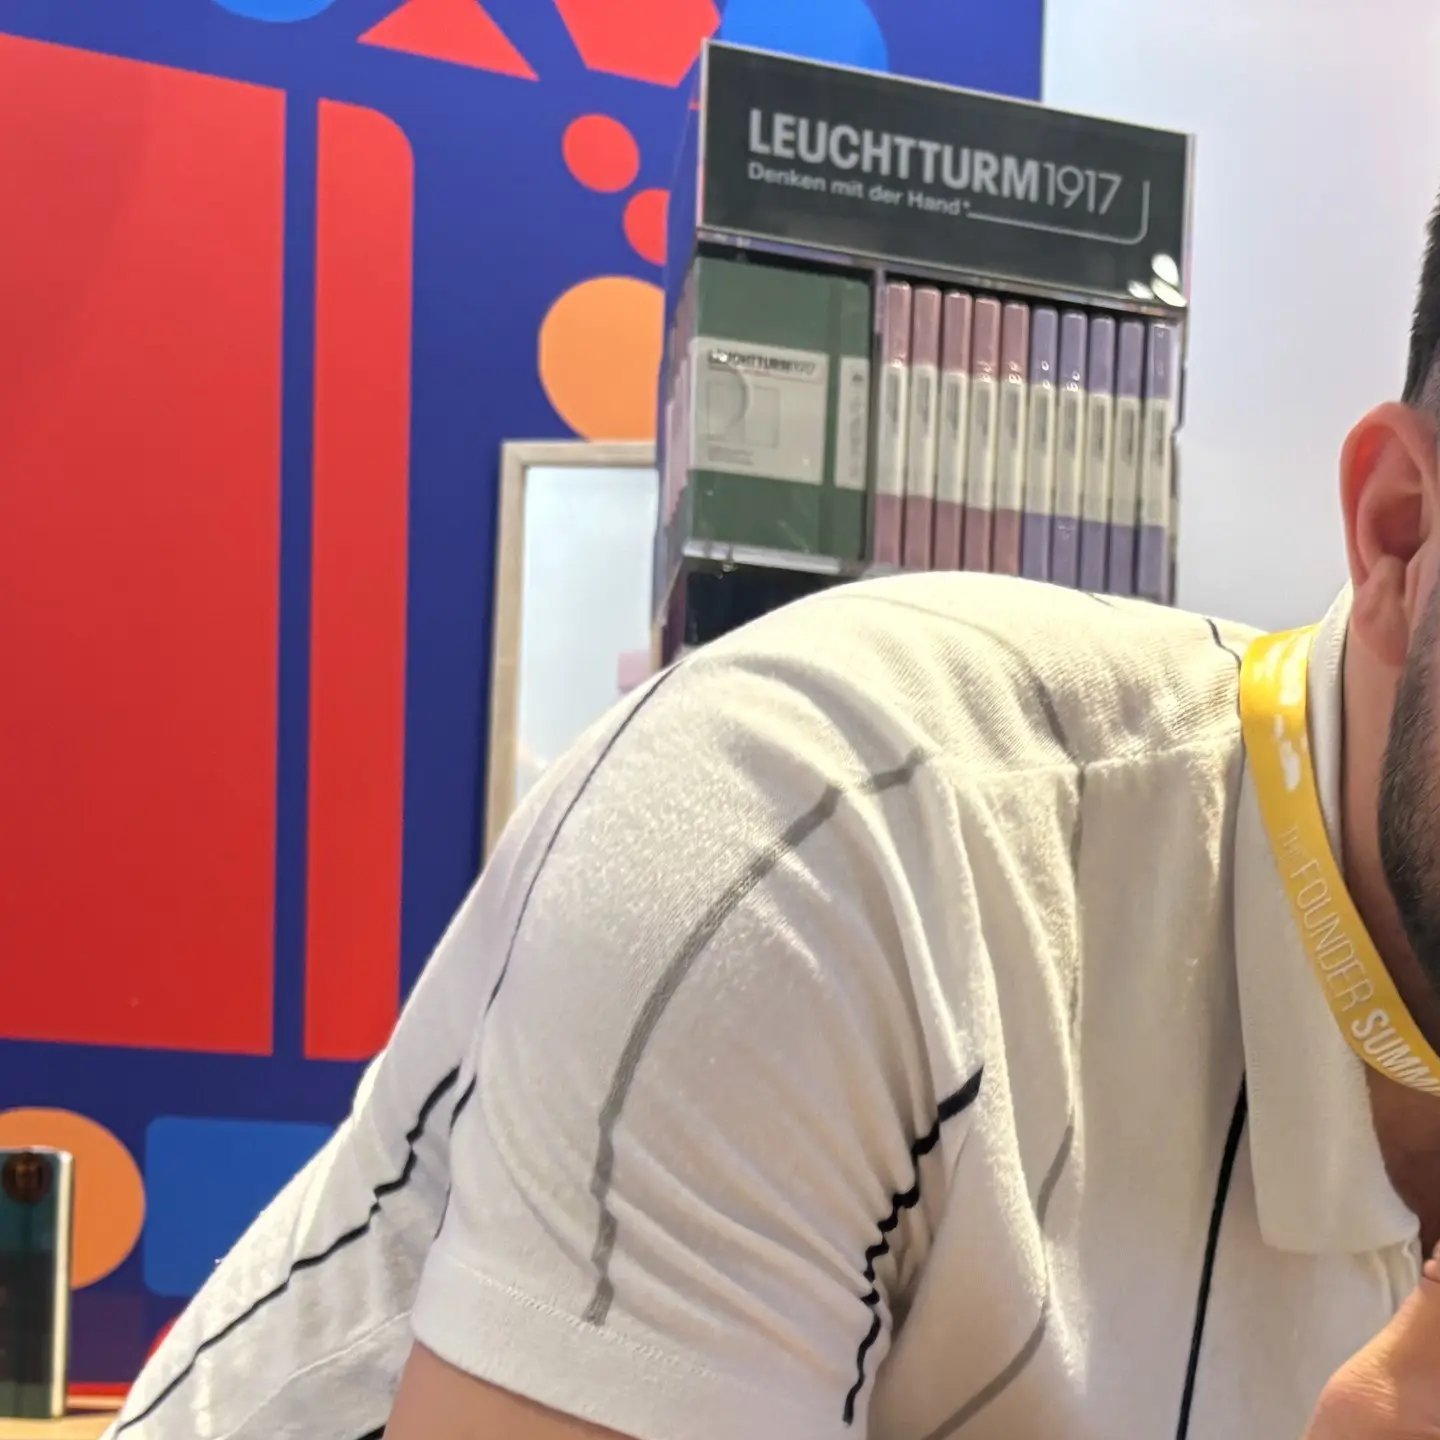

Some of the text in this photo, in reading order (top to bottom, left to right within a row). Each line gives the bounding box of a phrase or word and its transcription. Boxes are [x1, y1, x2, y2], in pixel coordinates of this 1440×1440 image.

[747, 161, 827, 193] Denken
[830, 178, 865, 199] mit
[867, 184, 903, 206] der
[748, 107, 1123, 216] LEUCHTTURM1917
[1289, 858, 1375, 1013] FOUNDER
